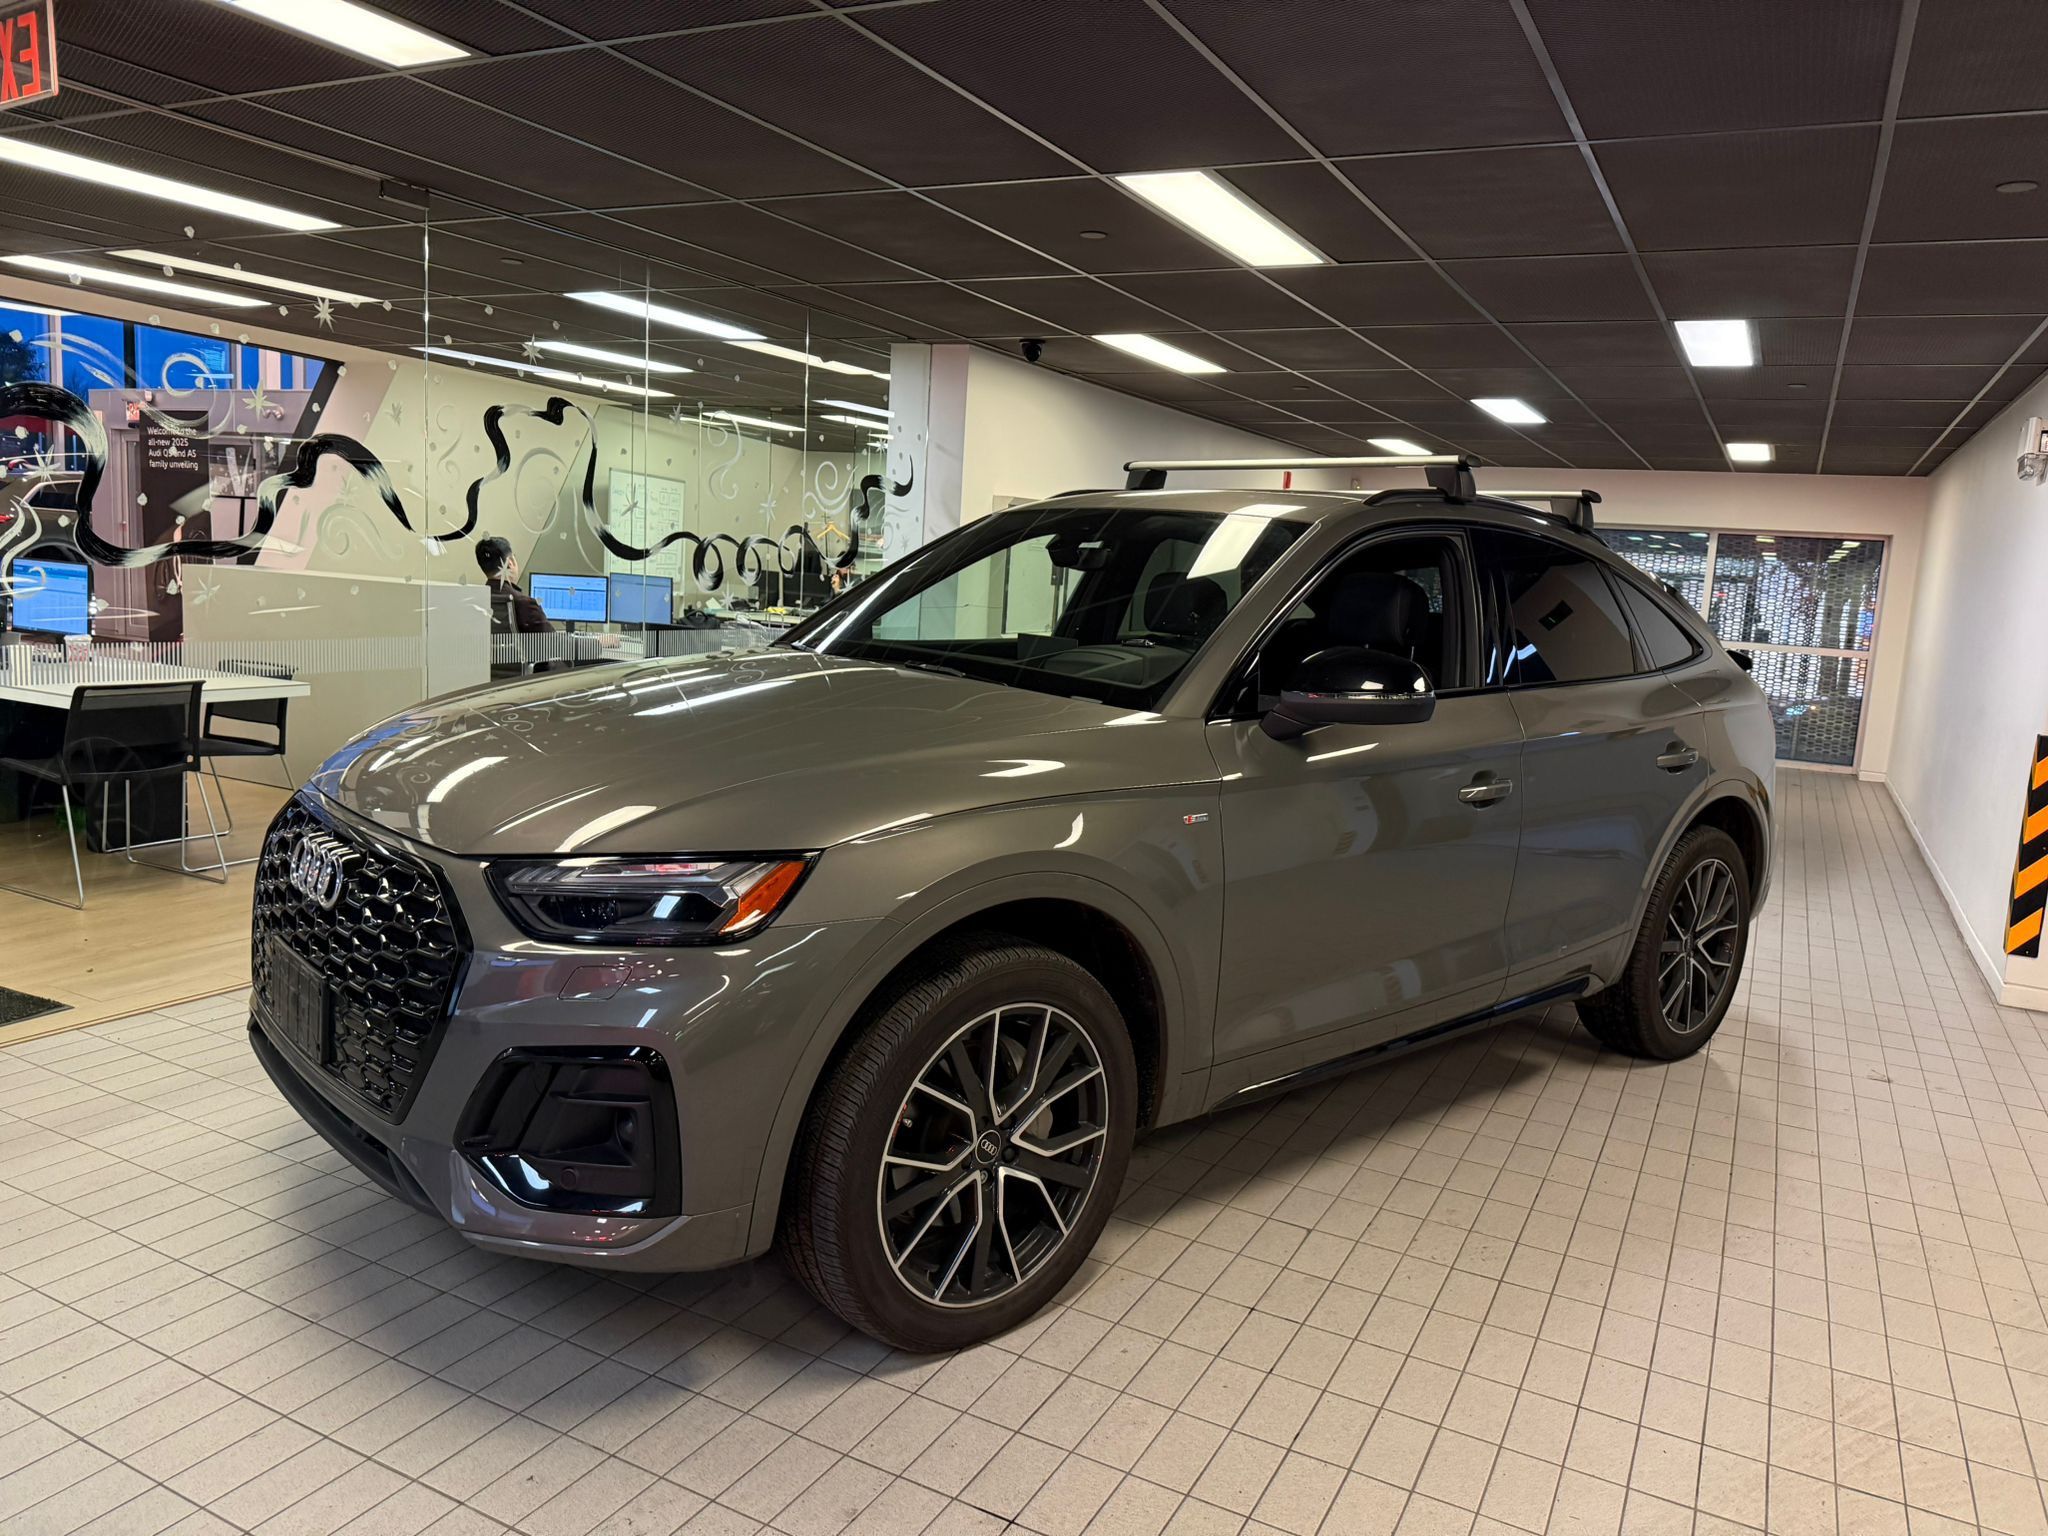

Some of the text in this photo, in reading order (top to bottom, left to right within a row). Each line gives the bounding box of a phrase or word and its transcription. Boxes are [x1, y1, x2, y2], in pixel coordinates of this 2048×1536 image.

[148, 438, 189, 447] all-new 2025
[148, 448, 162, 457] Audi
[187, 449, 197, 458] A5
[149, 459, 199, 471] family unveiling
